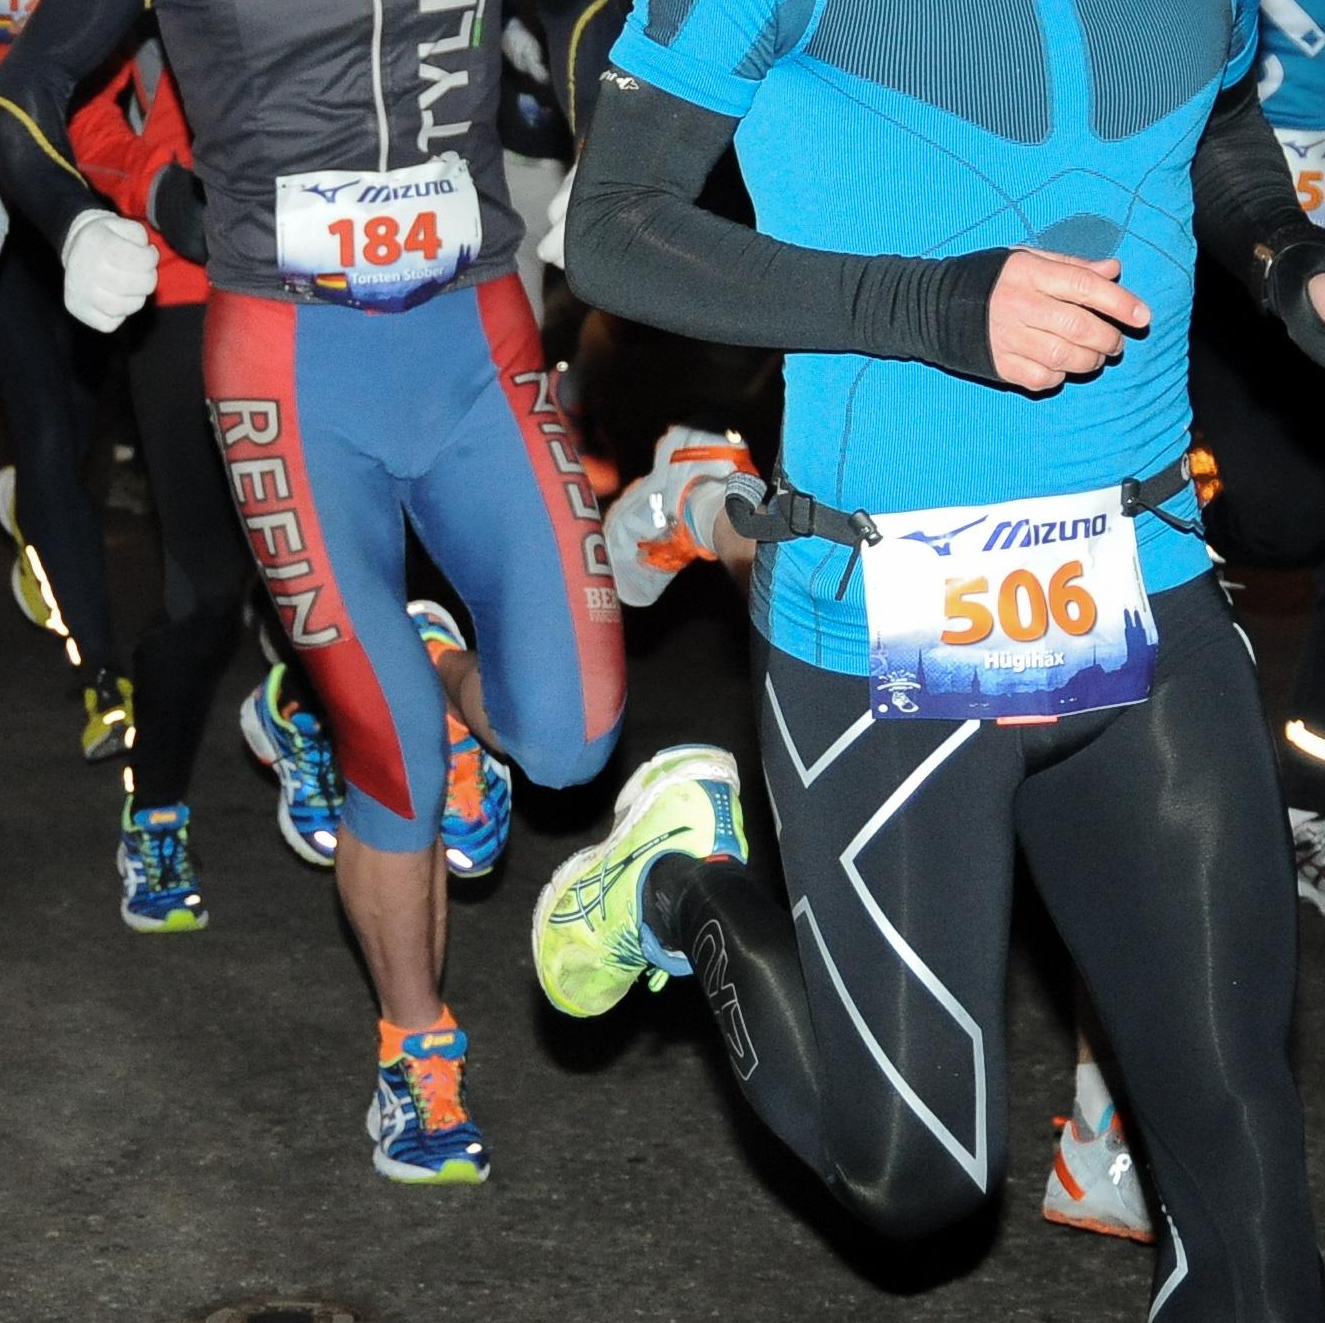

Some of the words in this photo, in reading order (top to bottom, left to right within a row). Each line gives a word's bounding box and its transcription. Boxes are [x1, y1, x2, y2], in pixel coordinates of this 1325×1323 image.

[328, 211, 443, 268] 184
[353, 272, 400, 284] Torsten
[217, 397, 342, 649] REFIN
[940, 559, 1097, 647] 506
